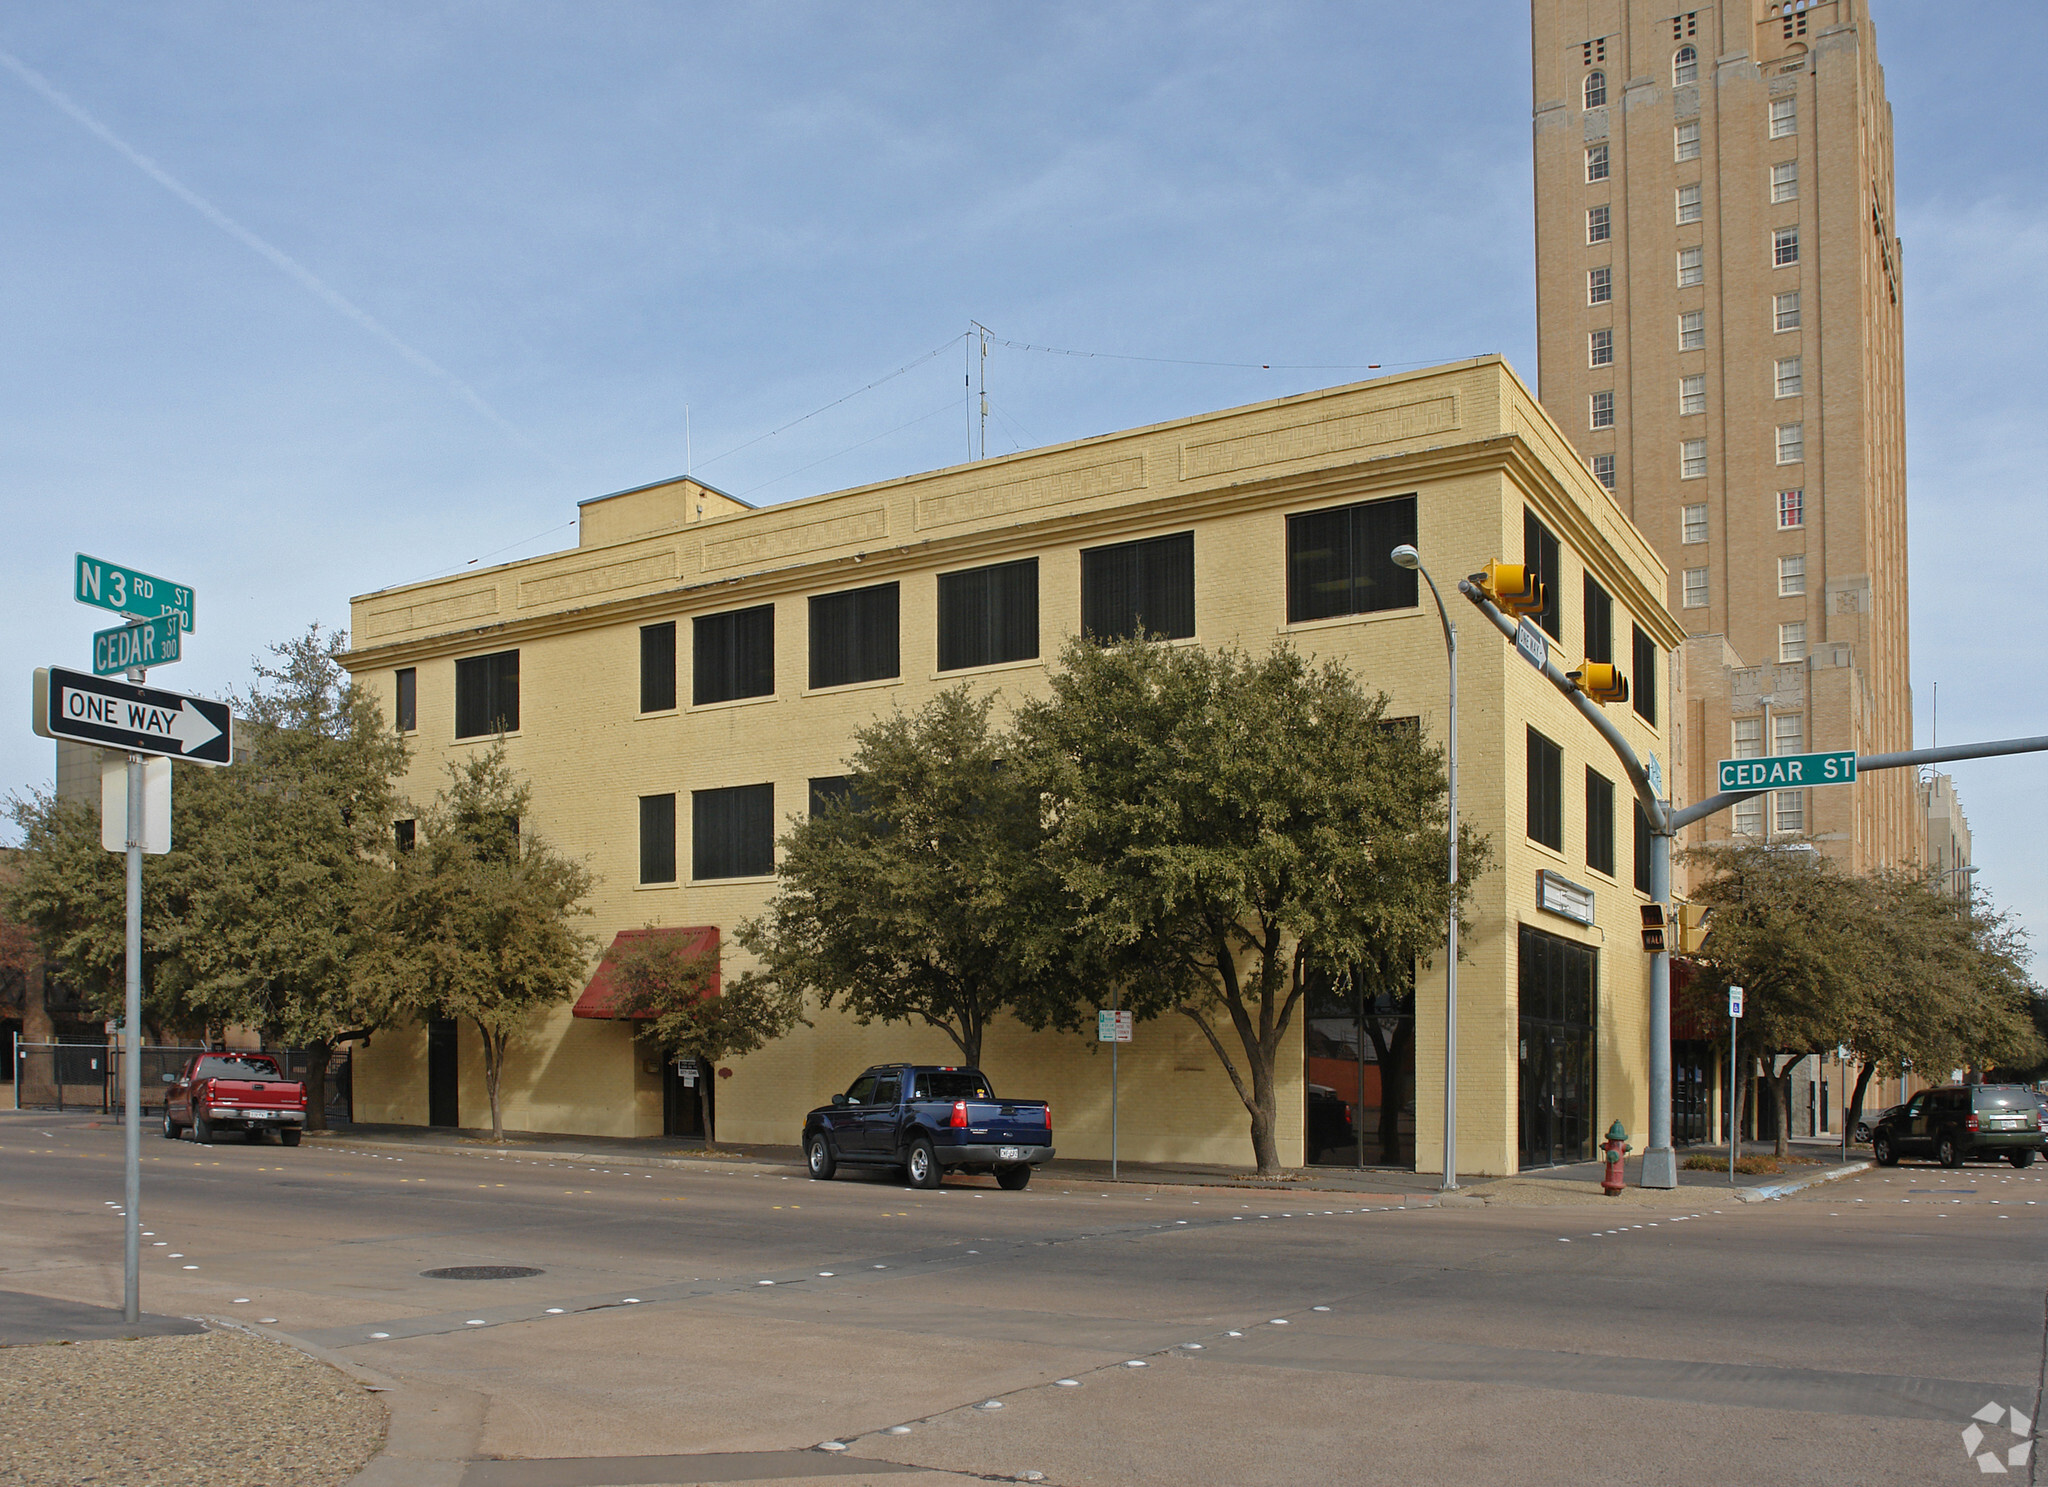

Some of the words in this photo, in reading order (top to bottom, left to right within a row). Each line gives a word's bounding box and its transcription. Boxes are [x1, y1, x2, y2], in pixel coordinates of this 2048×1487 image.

[82, 561, 101, 600] N
[174, 587, 189, 607] ST
[160, 604, 189, 628] 10
[95, 625, 155, 671] CEDAR
[167, 617, 177, 637] ST
[160, 638, 177, 660] 300
[69, 692, 118, 724] ONE
[128, 703, 177, 735] WAY
[1721, 761, 1803, 786] CEDAR
[1823, 757, 1854, 779] ST
